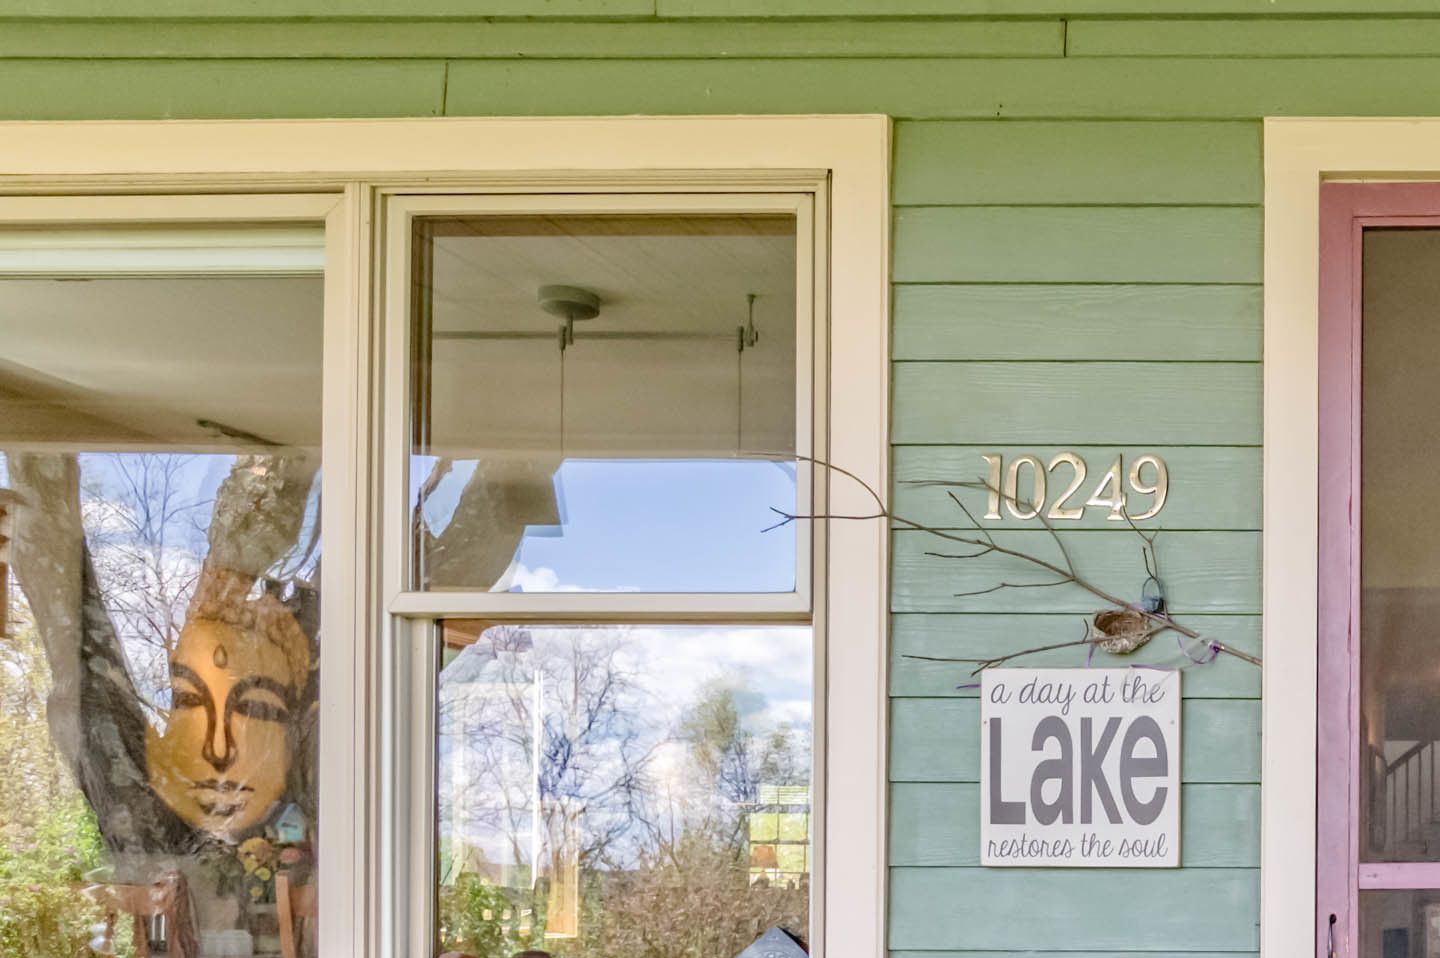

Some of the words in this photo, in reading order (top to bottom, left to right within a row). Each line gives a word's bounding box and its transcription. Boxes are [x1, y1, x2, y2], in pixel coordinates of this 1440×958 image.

[982, 452, 1168, 520] 10249
[990, 683, 1012, 704] a
[1019, 676, 1076, 716] day
[1083, 675, 1115, 704] at
[1122, 675, 1165, 704] the
[988, 832, 1075, 858] restores
[1081, 832, 1114, 858] the
[1118, 832, 1169, 858] soul
